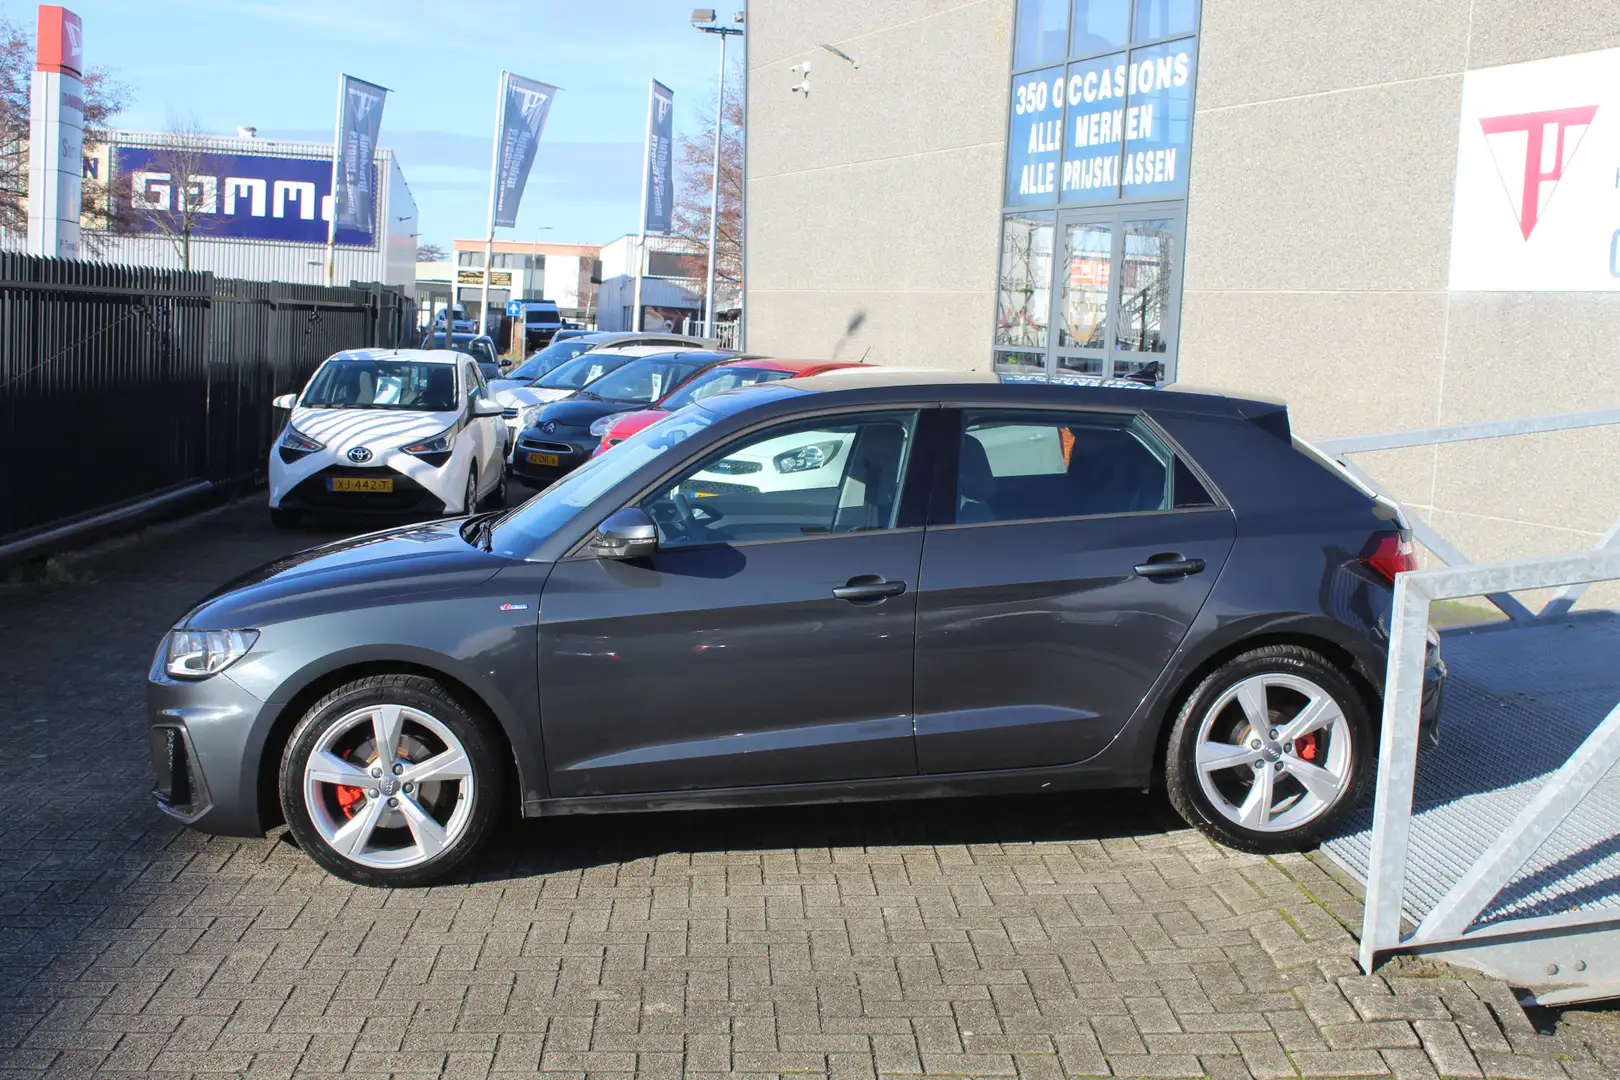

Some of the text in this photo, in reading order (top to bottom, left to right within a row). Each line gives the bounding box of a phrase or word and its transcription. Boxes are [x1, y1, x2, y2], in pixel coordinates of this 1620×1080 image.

[1016, 52, 1188, 115] 350 OCCASIONS
[1027, 104, 1153, 154] ALLE MERKEN
[1019, 162, 1055, 195] ALLE
